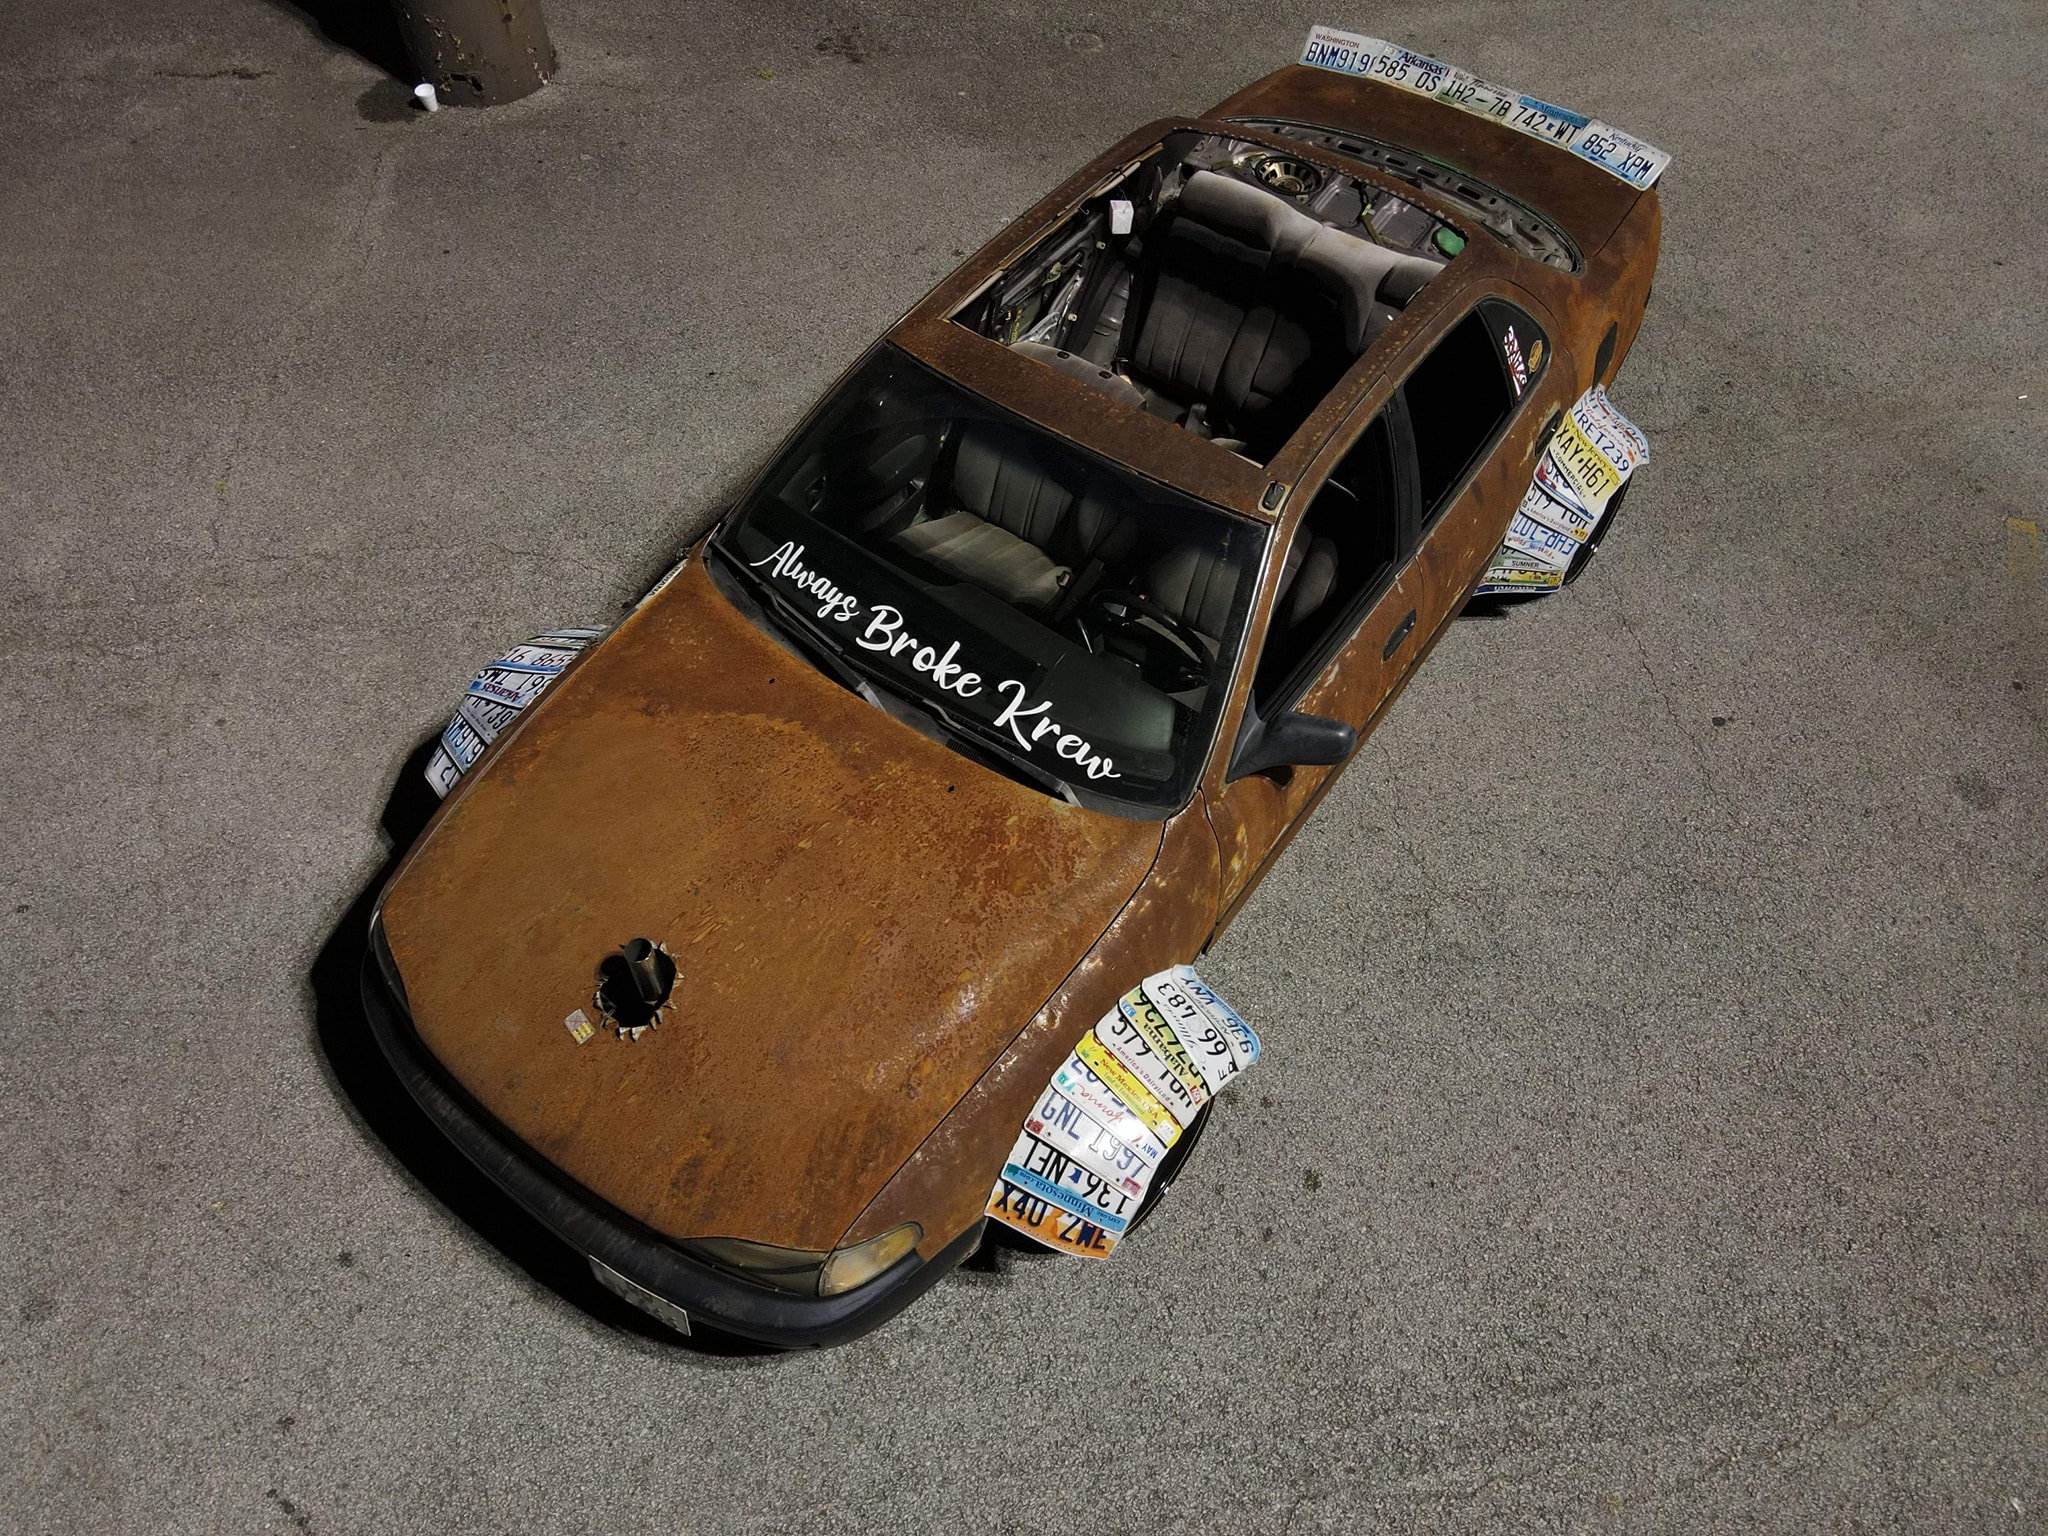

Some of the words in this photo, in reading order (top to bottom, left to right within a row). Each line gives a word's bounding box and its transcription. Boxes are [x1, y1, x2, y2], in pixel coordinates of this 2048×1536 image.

[1315, 33, 1360, 49] WASHINGTON
[1375, 54, 1411, 81] 585
[1398, 51, 1444, 76] Arkansas
[1512, 105, 1548, 132] 742
[1553, 120, 1582, 144] WT
[1540, 104, 1581, 124] Minnesota
[1581, 133, 1617, 161] 852
[1616, 151, 1655, 181] XPM
[1608, 132, 1642, 153] Kentucky
[1572, 429, 1590, 449] New
[1588, 443, 1608, 470] Jersey
[1553, 452, 1585, 498] COMMERCIAL
[1510, 559, 1540, 569] SUMNER
[750, 541, 860, 622] Always
[856, 604, 983, 698] Broke
[993, 679, 1122, 780] Krew
[480, 682, 526, 703] Arkansas
[1157, 982, 1198, 1019] 483
[1180, 976, 1216, 1006] VNY
[1143, 1022, 1189, 1077] Alabama
[1198, 1028, 1228, 1057] 66
[1221, 1016, 1255, 1054] 936
[1099, 1058, 1118, 1077] New
[1116, 1075, 1142, 1101] Mexico
[1141, 1098, 1159, 1119] USA
[1116, 1046, 1144, 1076] America's
[1143, 1073, 1171, 1102] Dairyland
[1040, 1090, 1081, 1141] GNL
[1140, 1142, 1160, 1160] MAY
[1017, 1170, 1095, 1219] Minnesota.com
[1083, 1171, 1128, 1216] 136
[1097, 1211, 1121, 1225] EXPLORE
